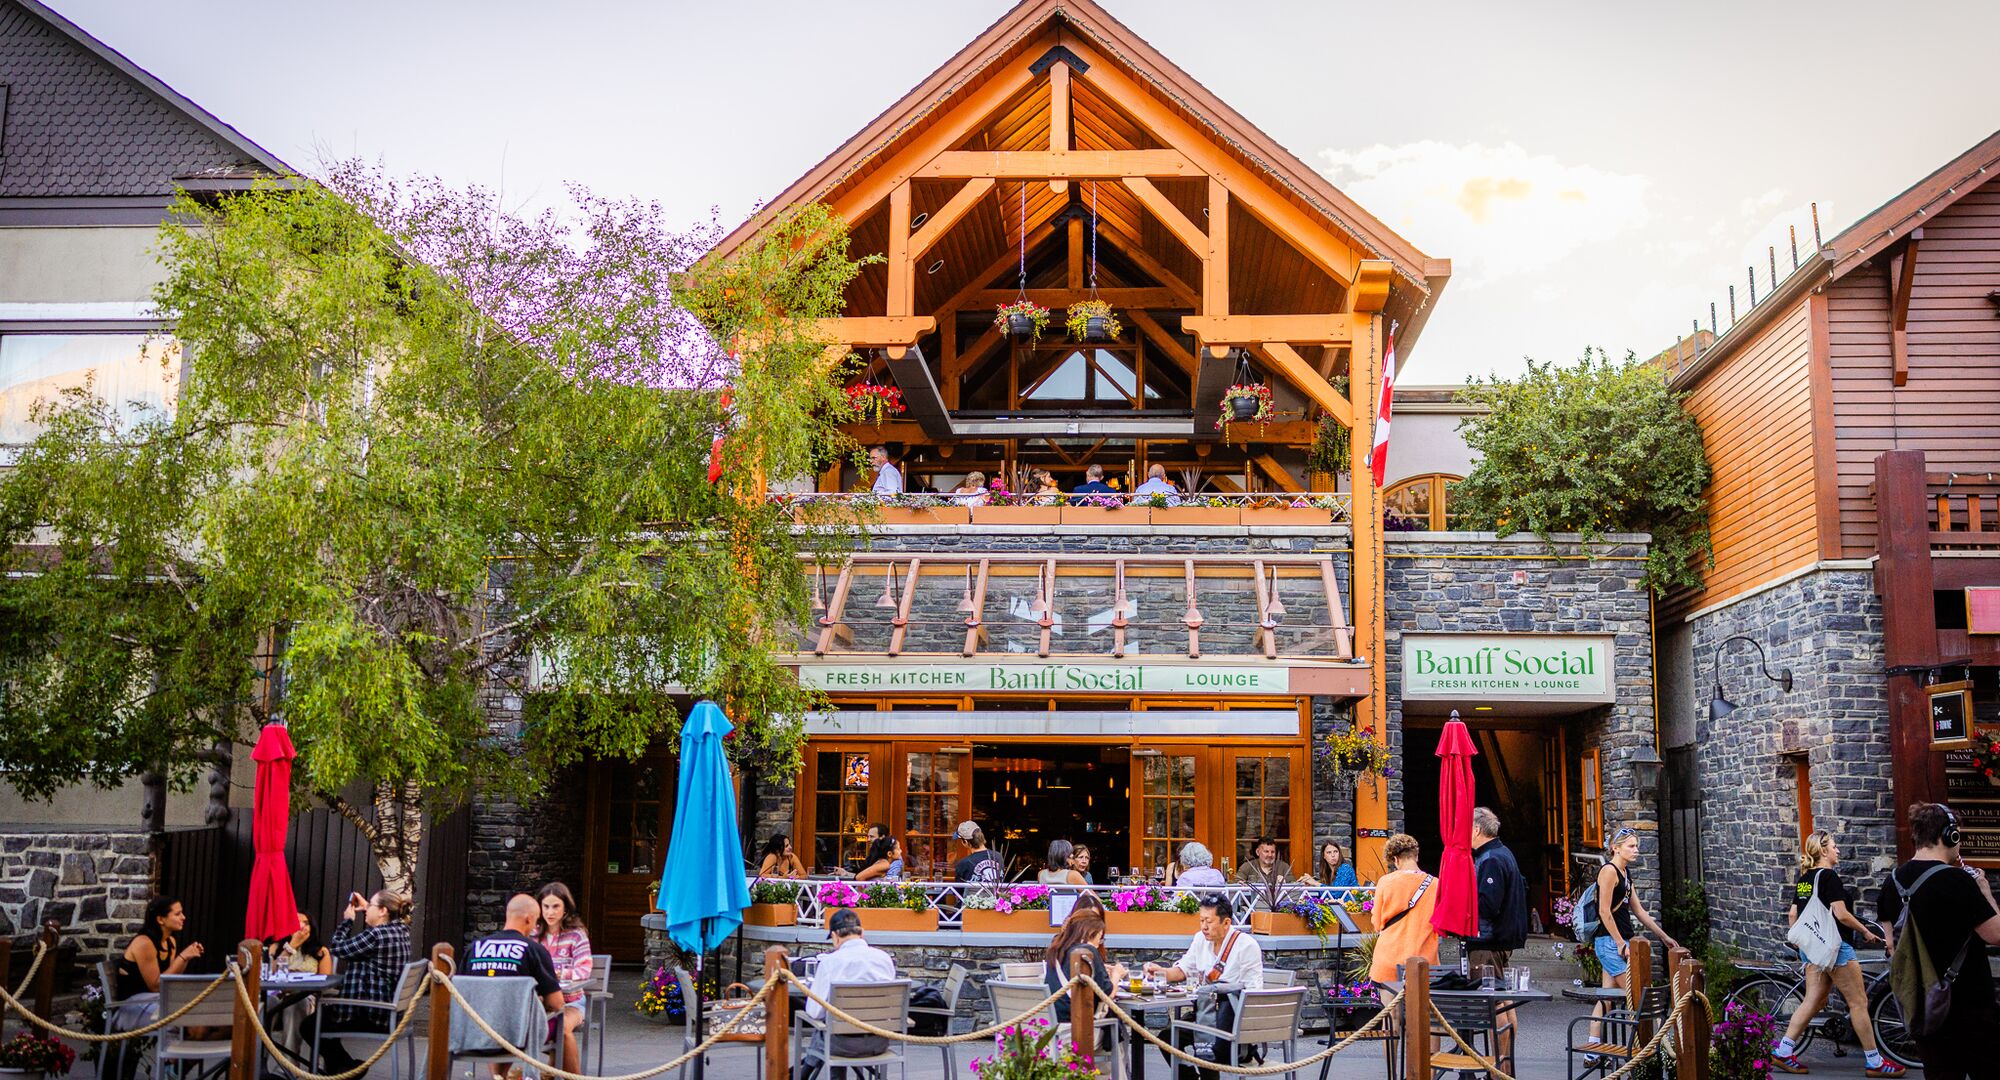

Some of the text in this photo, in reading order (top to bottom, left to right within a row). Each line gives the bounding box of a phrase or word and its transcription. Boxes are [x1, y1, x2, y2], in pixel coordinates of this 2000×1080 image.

[1415, 647, 1594, 675] Banff Social
[826, 666, 1259, 690] FRESH KITCHEN Banff Social LOUNGE
[1431, 680, 1467, 688] FRESH
[1471, 680, 1519, 688] KITCHEN
[1534, 680, 1580, 688] LOUNGE
[474, 939, 529, 960] VANS
[471, 962, 518, 972] AUSTRALIA
